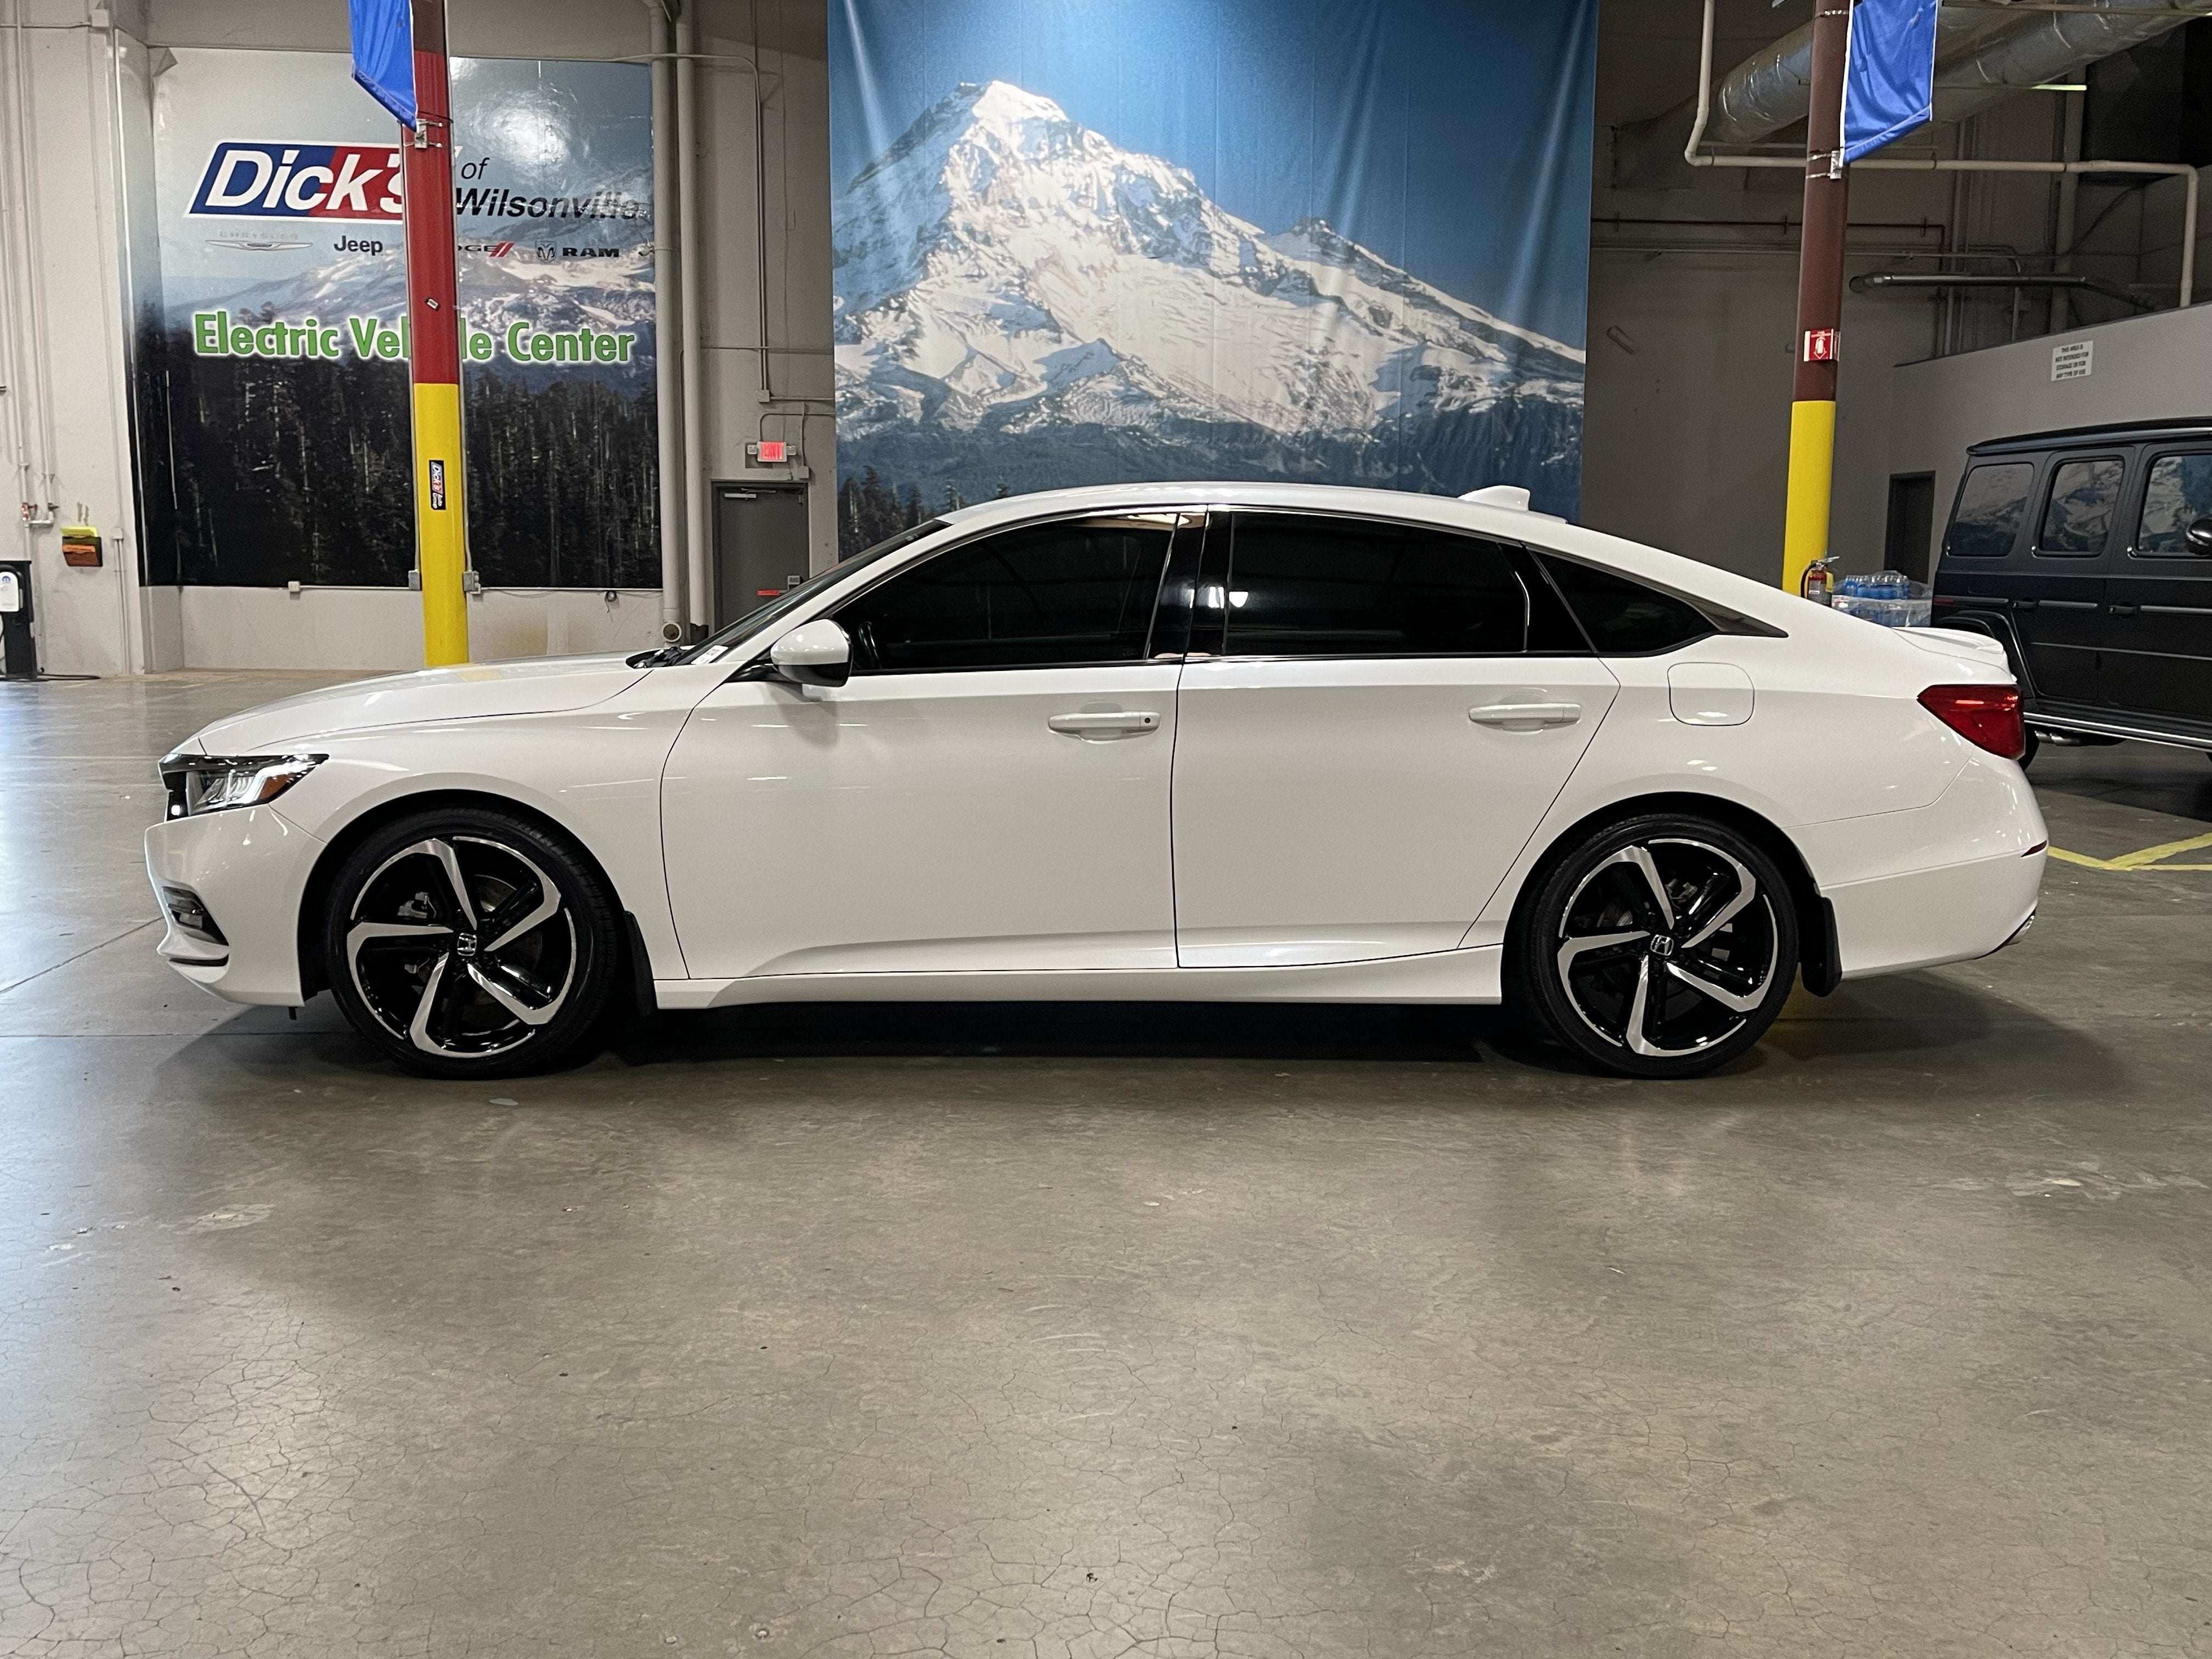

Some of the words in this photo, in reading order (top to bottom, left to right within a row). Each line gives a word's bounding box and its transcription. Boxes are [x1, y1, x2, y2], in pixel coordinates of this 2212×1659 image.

[461, 157, 490, 180] of
[456, 187, 639, 220] Wilsonville
[334, 235, 383, 256] Jeep
[562, 247, 619, 258] RAM
[195, 311, 339, 357] Electric
[349, 316, 492, 361] Vele
[508, 321, 635, 362] Center
